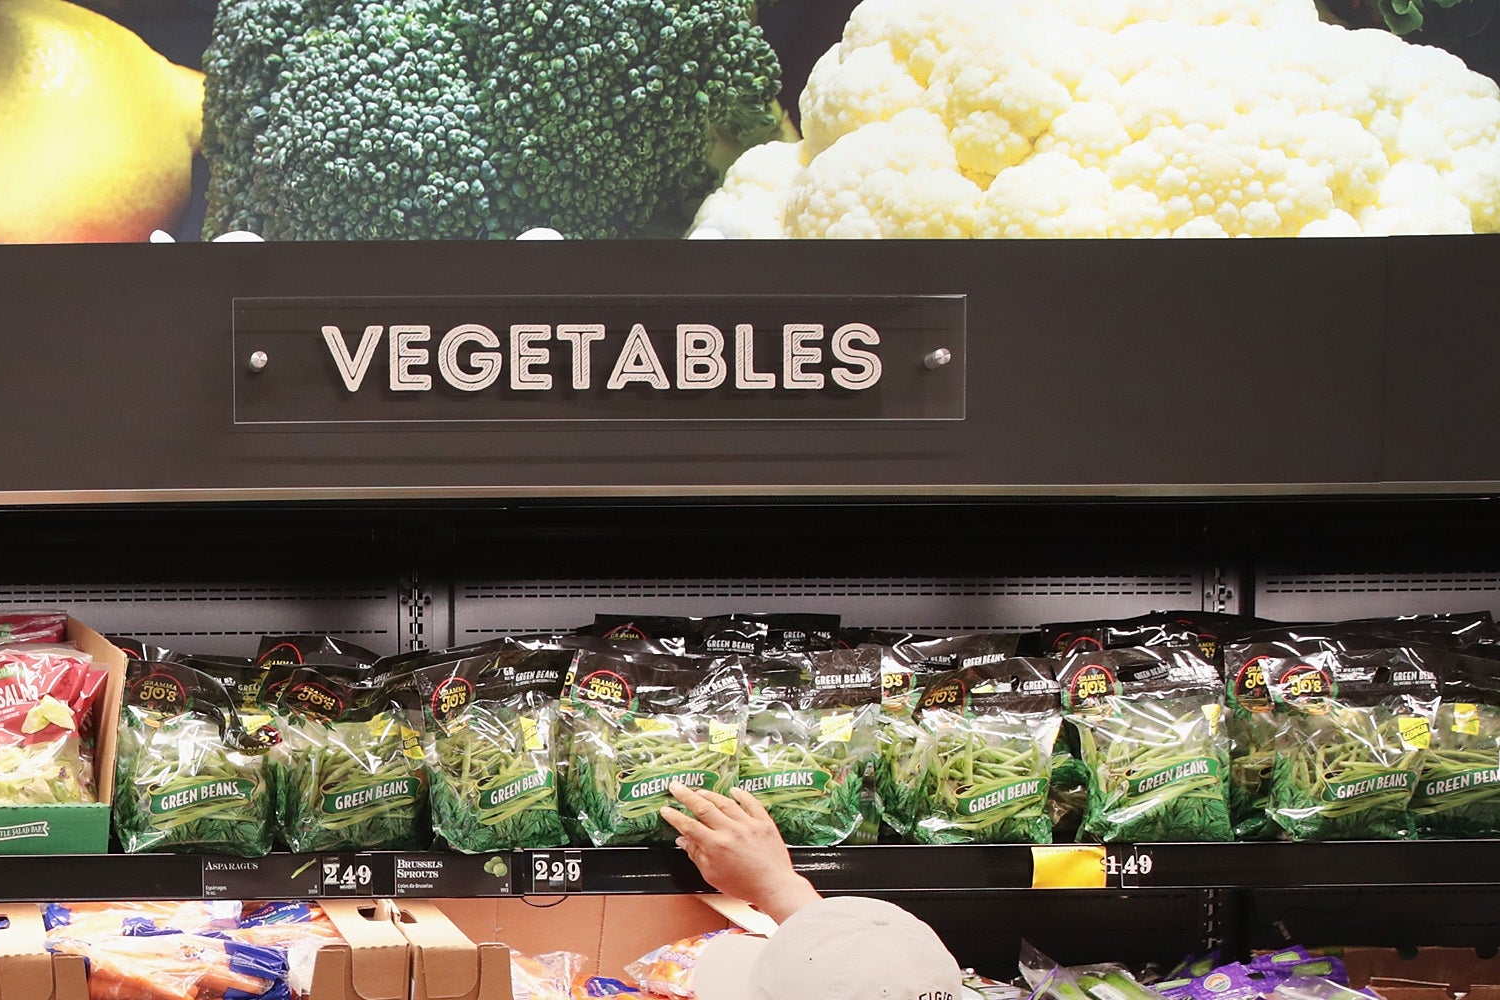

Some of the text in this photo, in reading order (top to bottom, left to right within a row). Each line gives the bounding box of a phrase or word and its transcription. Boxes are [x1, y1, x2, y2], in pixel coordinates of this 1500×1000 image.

[321, 323, 882, 392] VEGETABLES
[139, 685, 177, 702] JO'S
[1139, 760, 1209, 792] GREEN BEANS
[1336, 770, 1408, 799] GREEN BEANS
[161, 781, 240, 810] GREEN BEANS
[335, 779, 409, 810] GREEN BEANS
[969, 779, 1040, 813] GREEN BEANS
[11, 826, 28, 836] SALAD
[29, 824, 44, 834] BAR
[205, 862, 259, 871] ASPARAGUS
[324, 863, 372, 885] 2.49
[397, 859, 443, 869] BRUSSELS
[397, 869, 439, 878] SPROUTS
[535, 860, 581, 882] 2.29
[1107, 854, 1153, 875] 1.49
